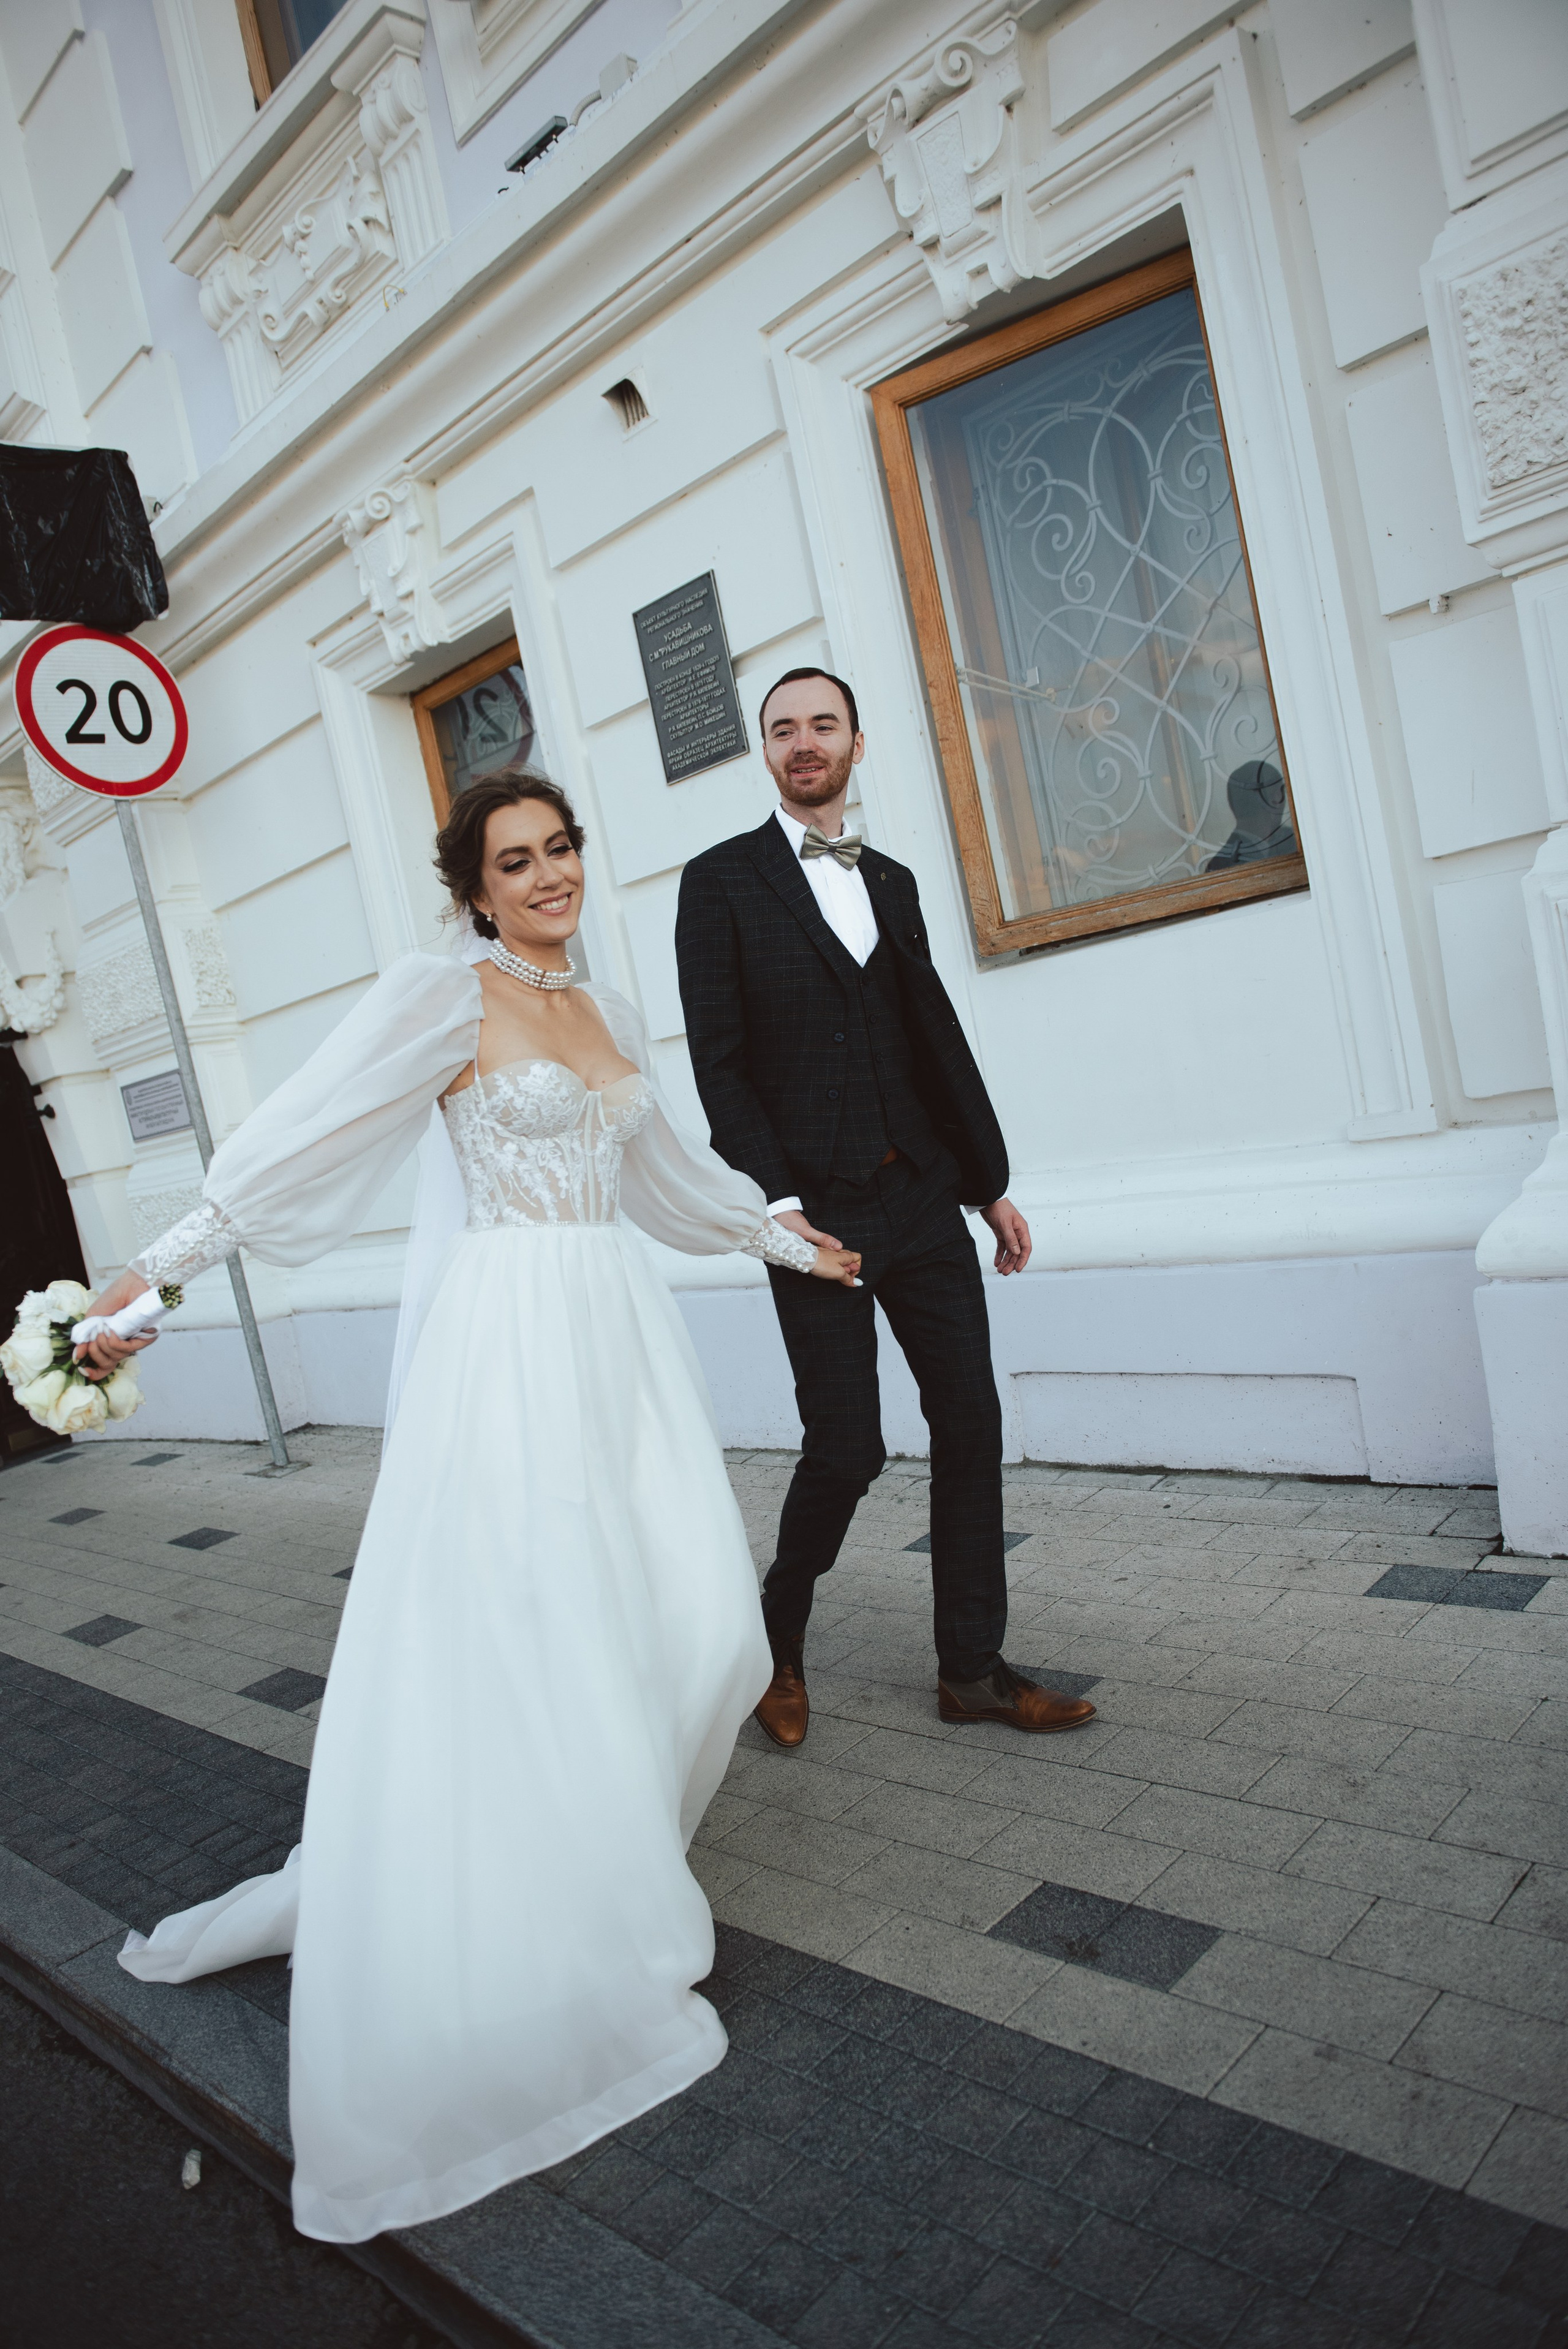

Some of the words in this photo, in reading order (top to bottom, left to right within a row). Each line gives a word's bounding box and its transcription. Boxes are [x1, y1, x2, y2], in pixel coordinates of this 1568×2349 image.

[661, 623, 713, 656] РУКАВИШНИКОВА
[664, 622, 692, 643] УСАДЬБА
[662, 649, 690, 670] ГЛАВНЫЙ
[691, 641, 705, 656] ДОМ
[655, 676, 676, 690] ПОСТРОЕН
[679, 668, 692, 679] КОНЦЕ
[705, 655, 720, 666] ГОДОВ
[662, 678, 687, 695] АРХИТЕКТОР
[664, 694, 689, 710] АРХИТЕКТОР
[666, 686, 691, 702] ПЕРЕСТРОЕН
[704, 675, 715, 684] ГОДУ
[56, 679, 152, 744] 20
[662, 705, 687, 721] ПЕРЕСТРОЕН
[711, 687, 726, 698] ГОДАХ
[680, 703, 709, 720] АРХИТЕКТОРЫ
[670, 725, 694, 740] СКУЛЬПТОР
[704, 711, 726, 725] МИКЕШИН
[667, 746, 685, 758] ФАСАДЫ
[691, 732, 717, 747] ИНТЕРЬЕРЫ
[718, 724, 736, 736] ЗДАНИЯ
[669, 755, 682, 765] ЯРКИЙ
[684, 746, 704, 758] ОБРАЗЕЦ
[705, 732, 737, 749] АРХИТЕКТУРЫ
[672, 751, 709, 770] АКАДЕМИЧЕСКОЙ
[710, 739, 736, 754] ЭКЛЕКТИКИ
